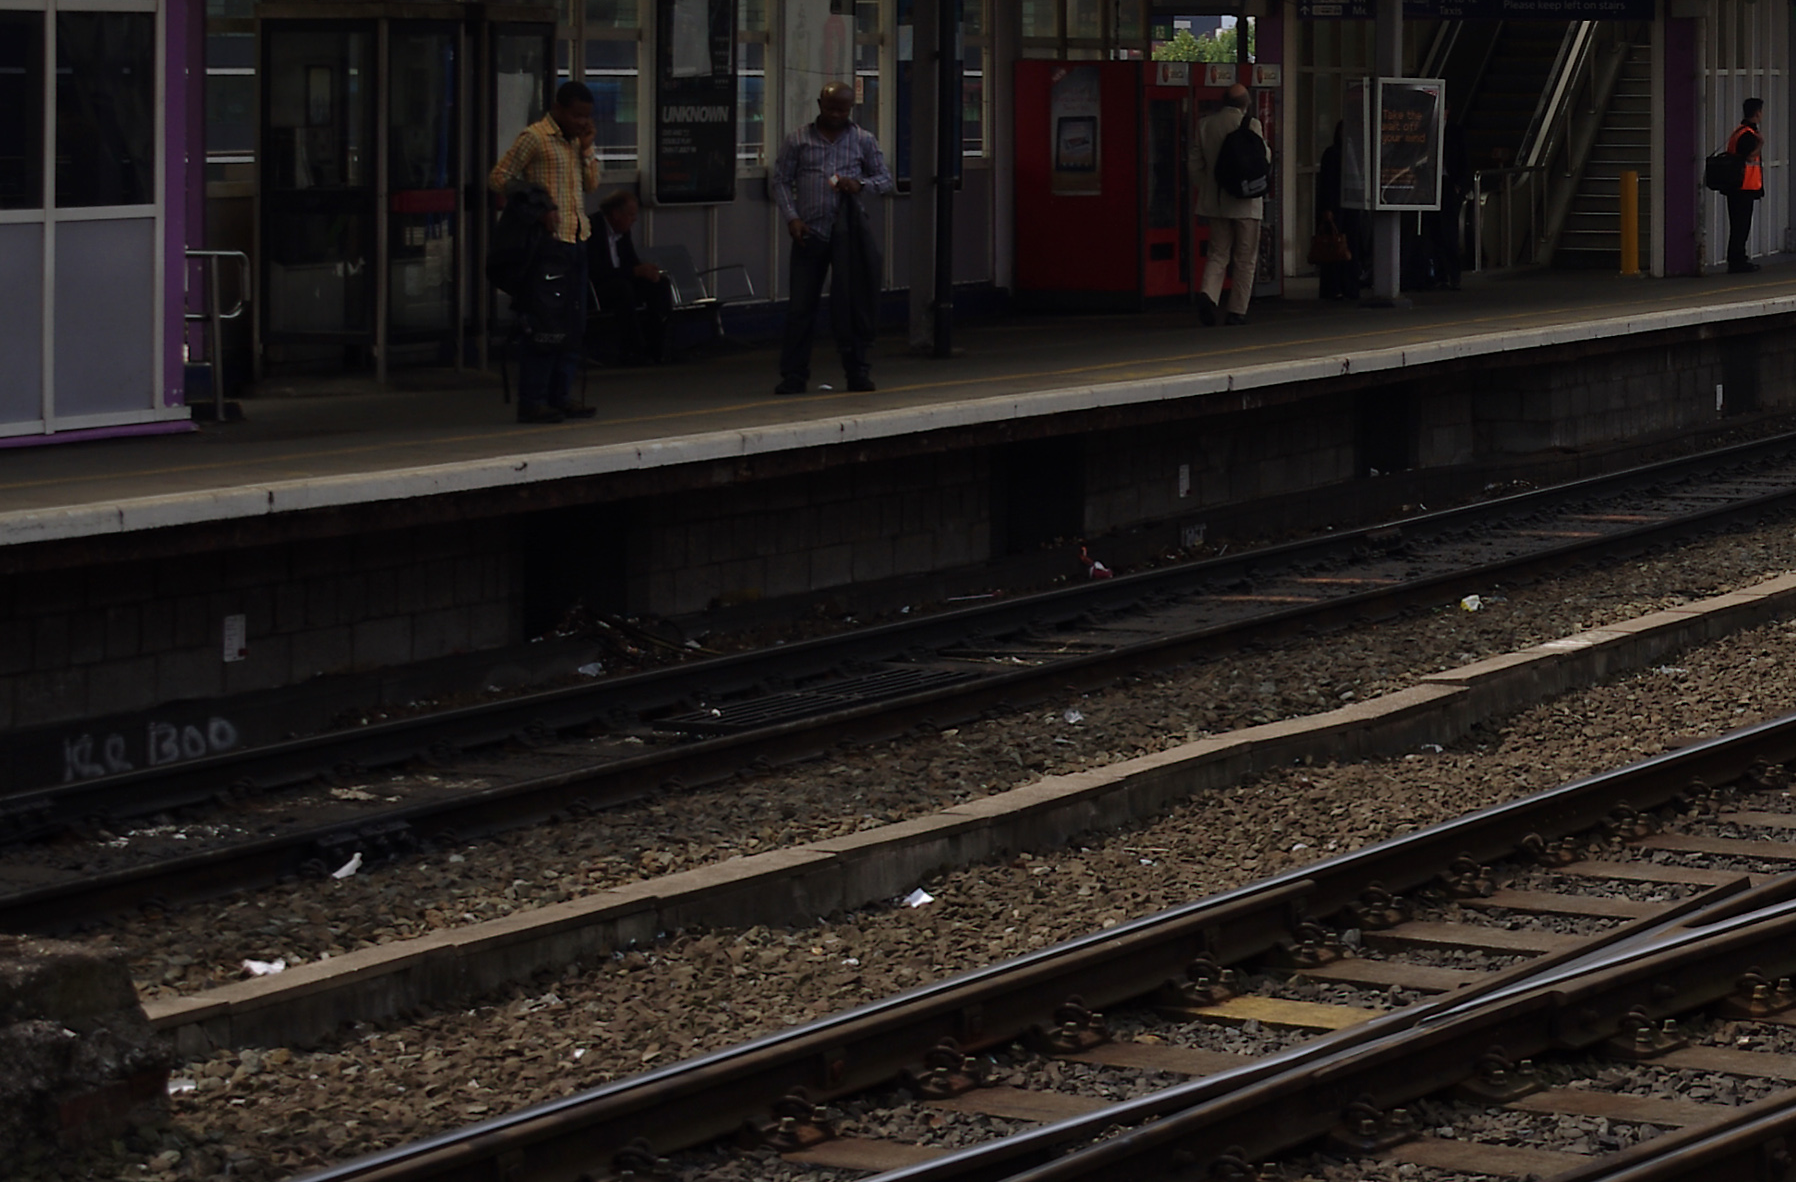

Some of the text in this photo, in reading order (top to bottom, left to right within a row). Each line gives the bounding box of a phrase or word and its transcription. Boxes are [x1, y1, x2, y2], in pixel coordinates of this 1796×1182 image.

[1440, 5, 1462, 16] Taxis
[1503, 0, 1626, 12] Please keep left on stairs
[661, 105, 730, 124] UNKNOWN
[1383, 109, 1404, 120] Take
[1402, 121, 1420, 132] off
